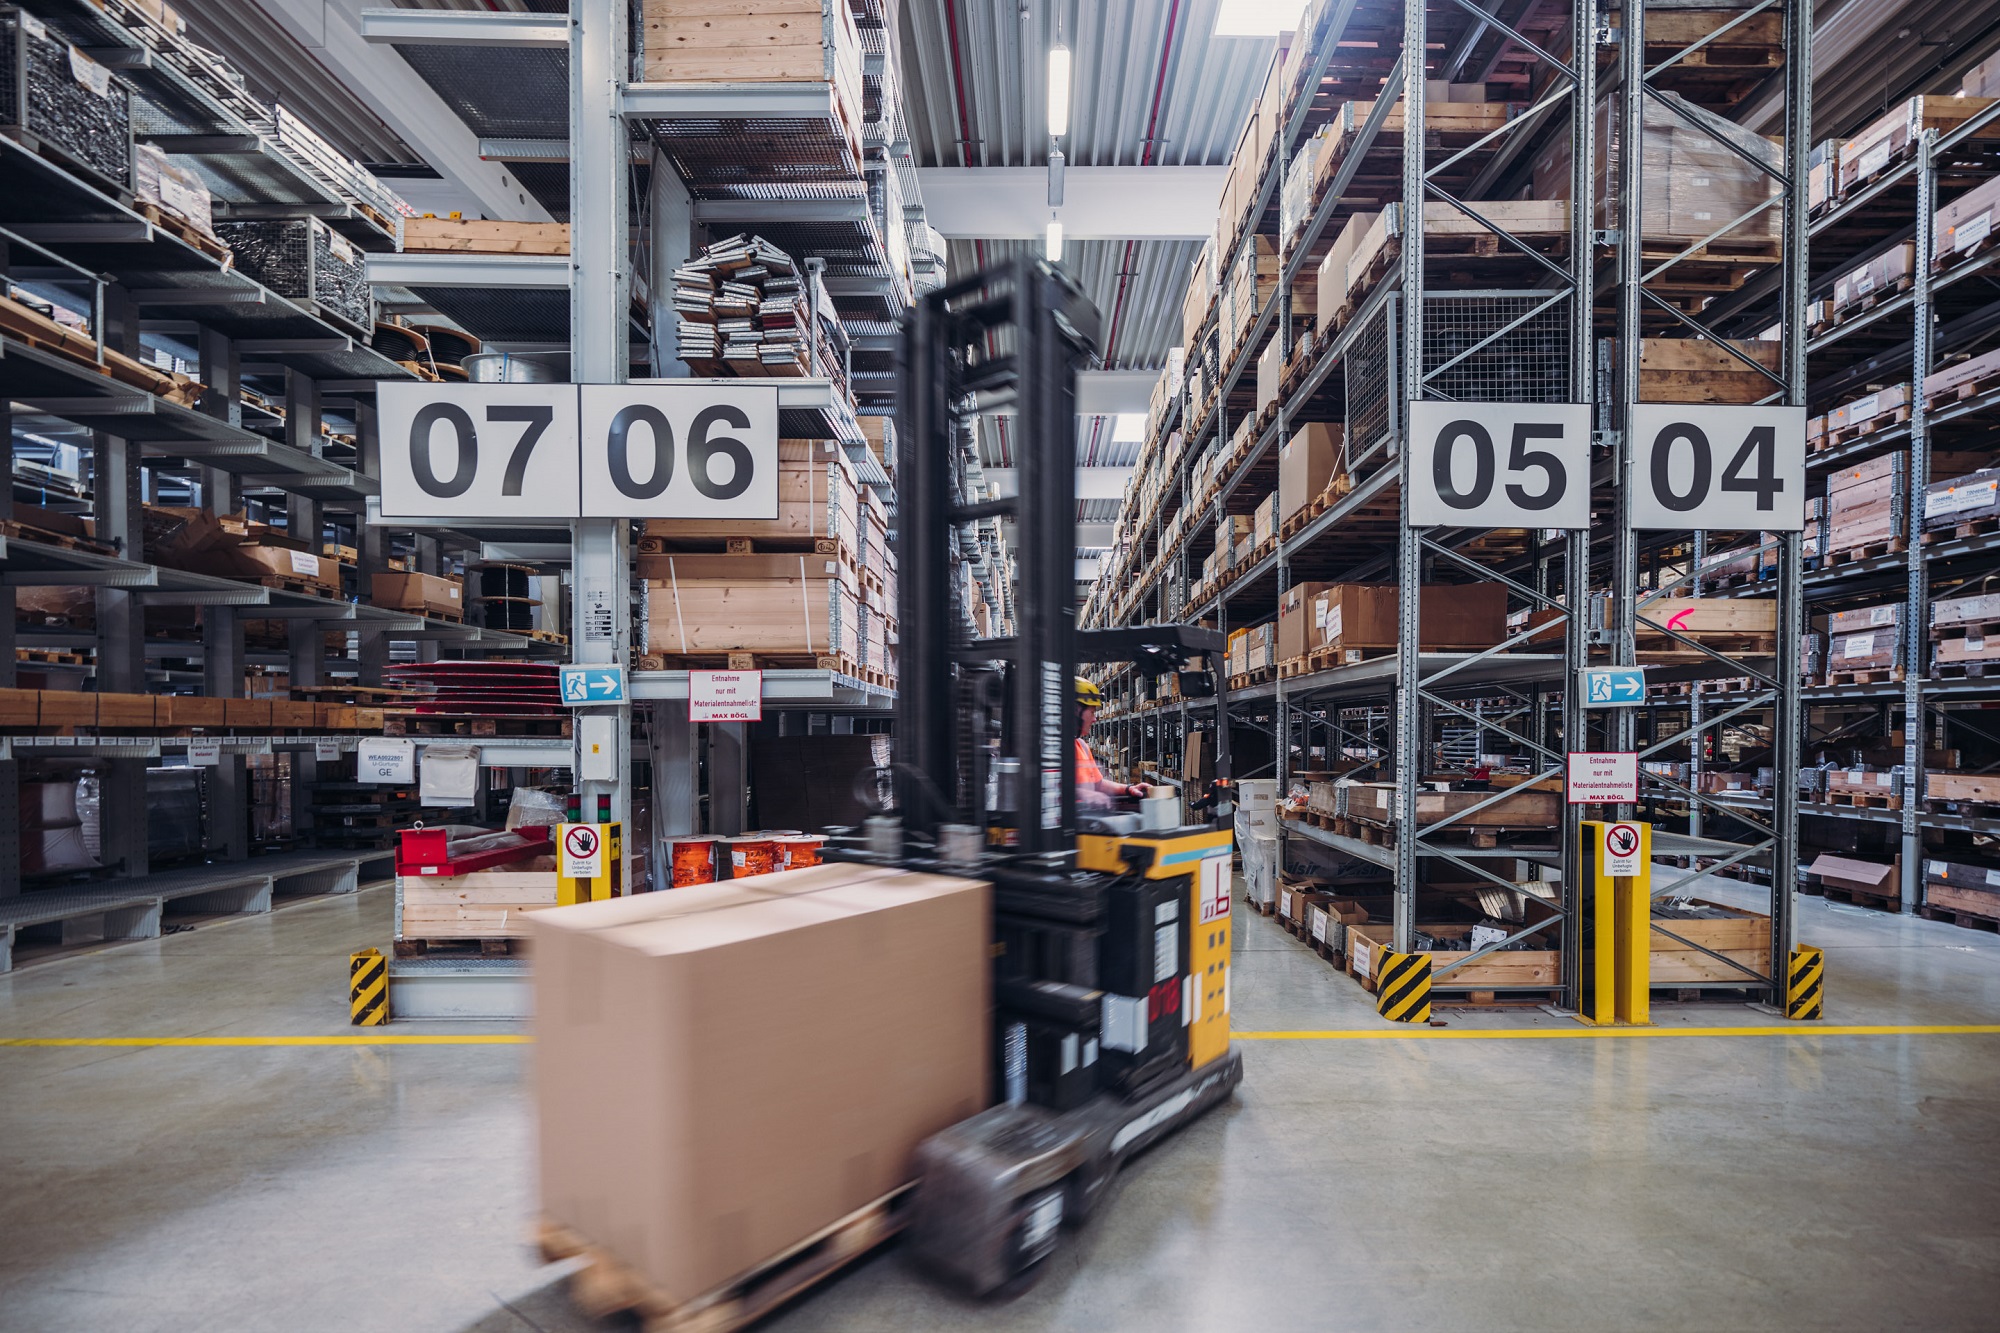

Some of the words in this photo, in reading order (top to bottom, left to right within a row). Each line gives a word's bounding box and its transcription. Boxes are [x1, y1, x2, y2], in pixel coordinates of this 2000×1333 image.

[409, 402, 553, 498] 07
[607, 404, 754, 500] 06
[1432, 419, 1567, 511] 05
[1650, 422, 1784, 512] 04
[711, 674, 740, 682] Entnahme
[378, 768, 392, 776] GE
[1589, 756, 1617, 764] Entnahme
[1572, 781, 1633, 789] Materialentnahmeliste
